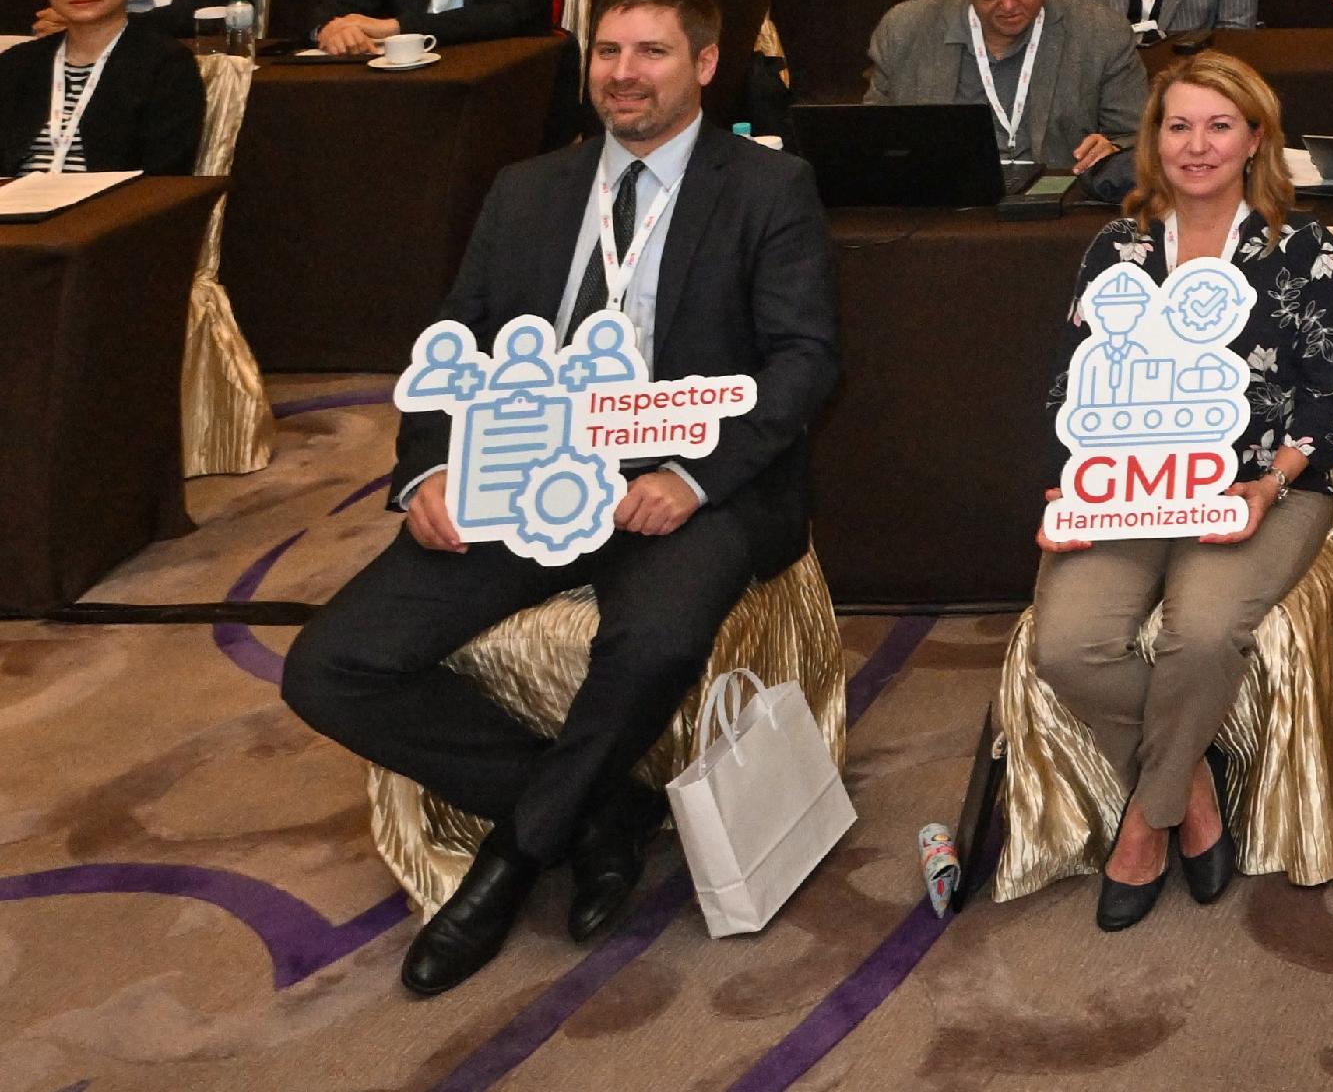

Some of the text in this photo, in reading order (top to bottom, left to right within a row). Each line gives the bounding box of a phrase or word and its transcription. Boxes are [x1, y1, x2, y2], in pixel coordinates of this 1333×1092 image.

[588, 385, 745, 417] Inspectors
[585, 418, 708, 449] Training
[1073, 451, 1227, 506] GMP
[1055, 506, 1238, 531] Harmonization
